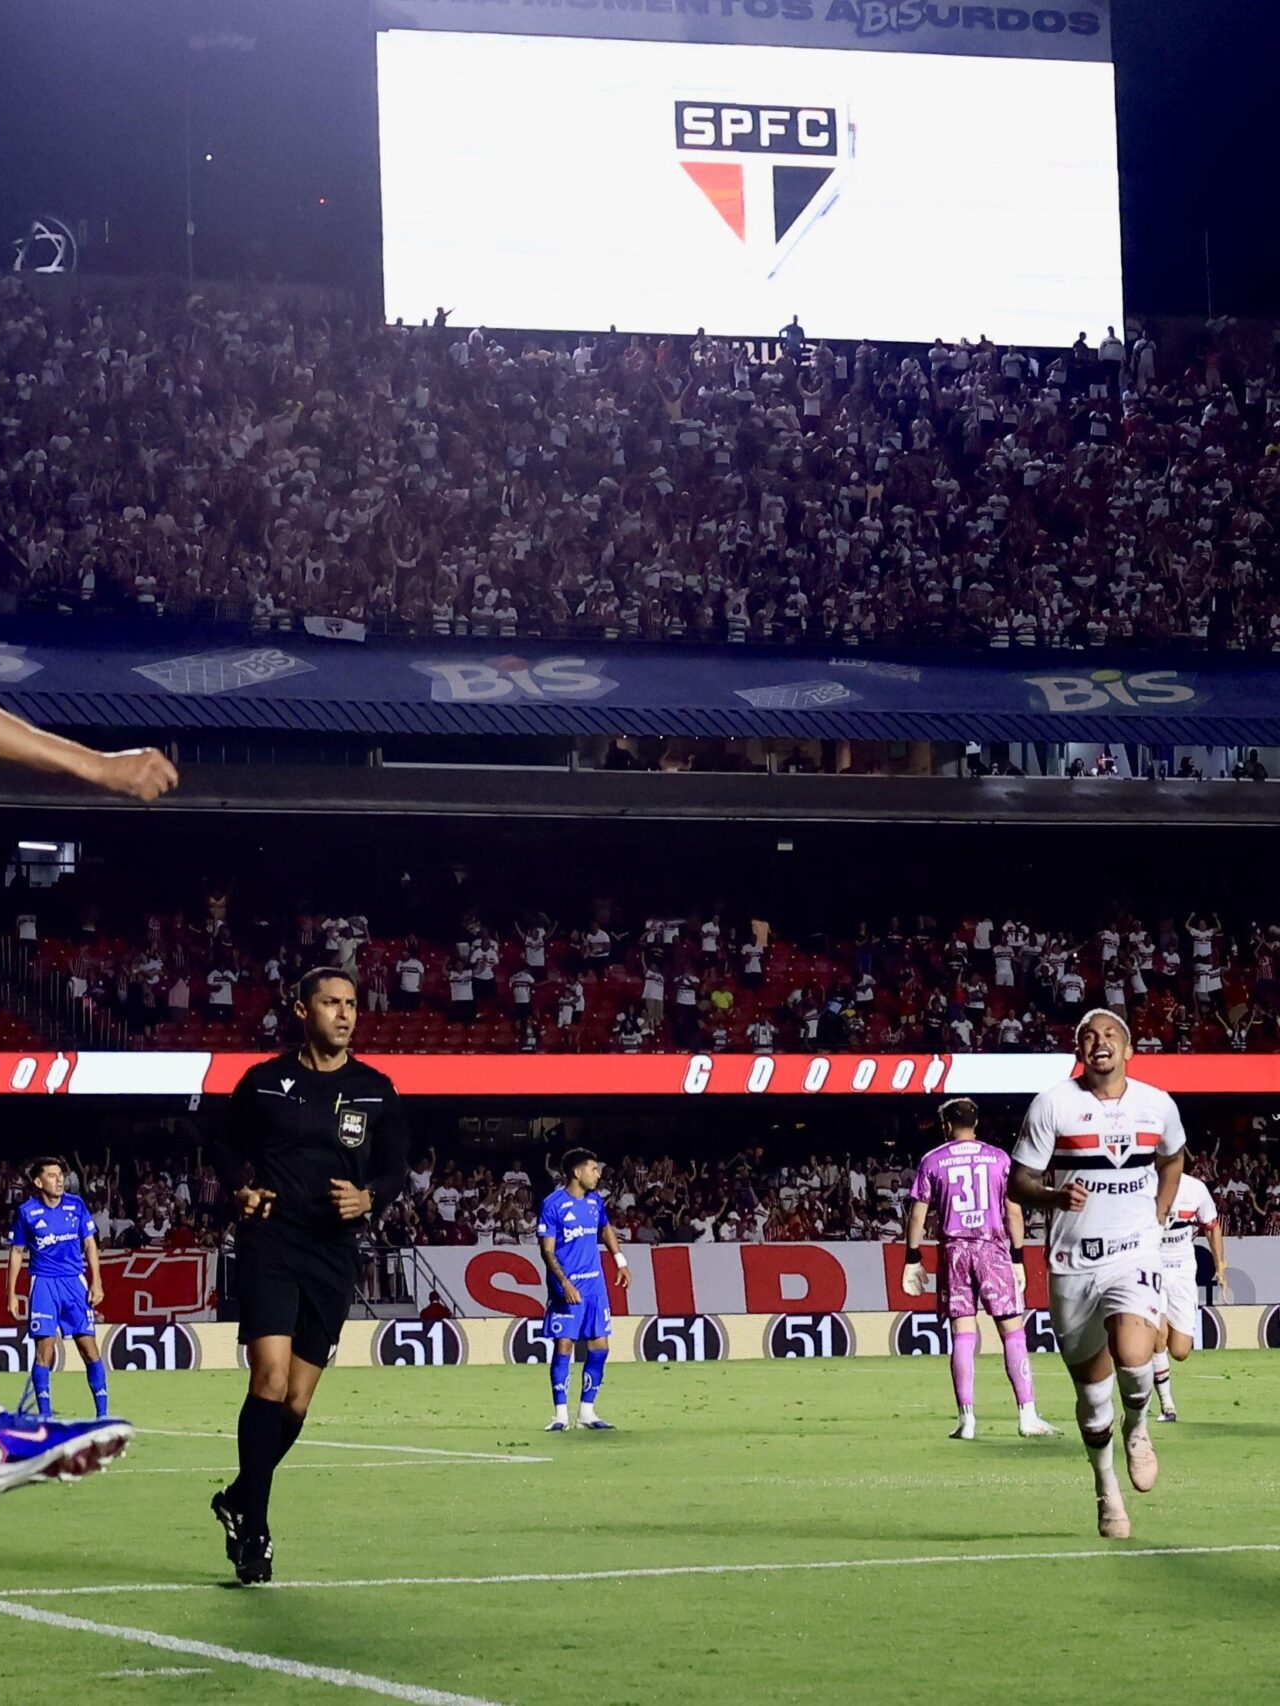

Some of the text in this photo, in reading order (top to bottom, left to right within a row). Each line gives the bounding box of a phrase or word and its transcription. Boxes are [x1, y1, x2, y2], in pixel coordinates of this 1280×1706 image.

[681, 107, 830, 148] SPFC
[948, 1164, 989, 1212] 31
[1136, 1268, 1162, 1294] 10
[126, 1325, 176, 1371] 51
[395, 1321, 444, 1366] 51
[657, 1317, 705, 1362] 51
[785, 1315, 832, 1358] 51
[911, 1313, 954, 1356] 51
